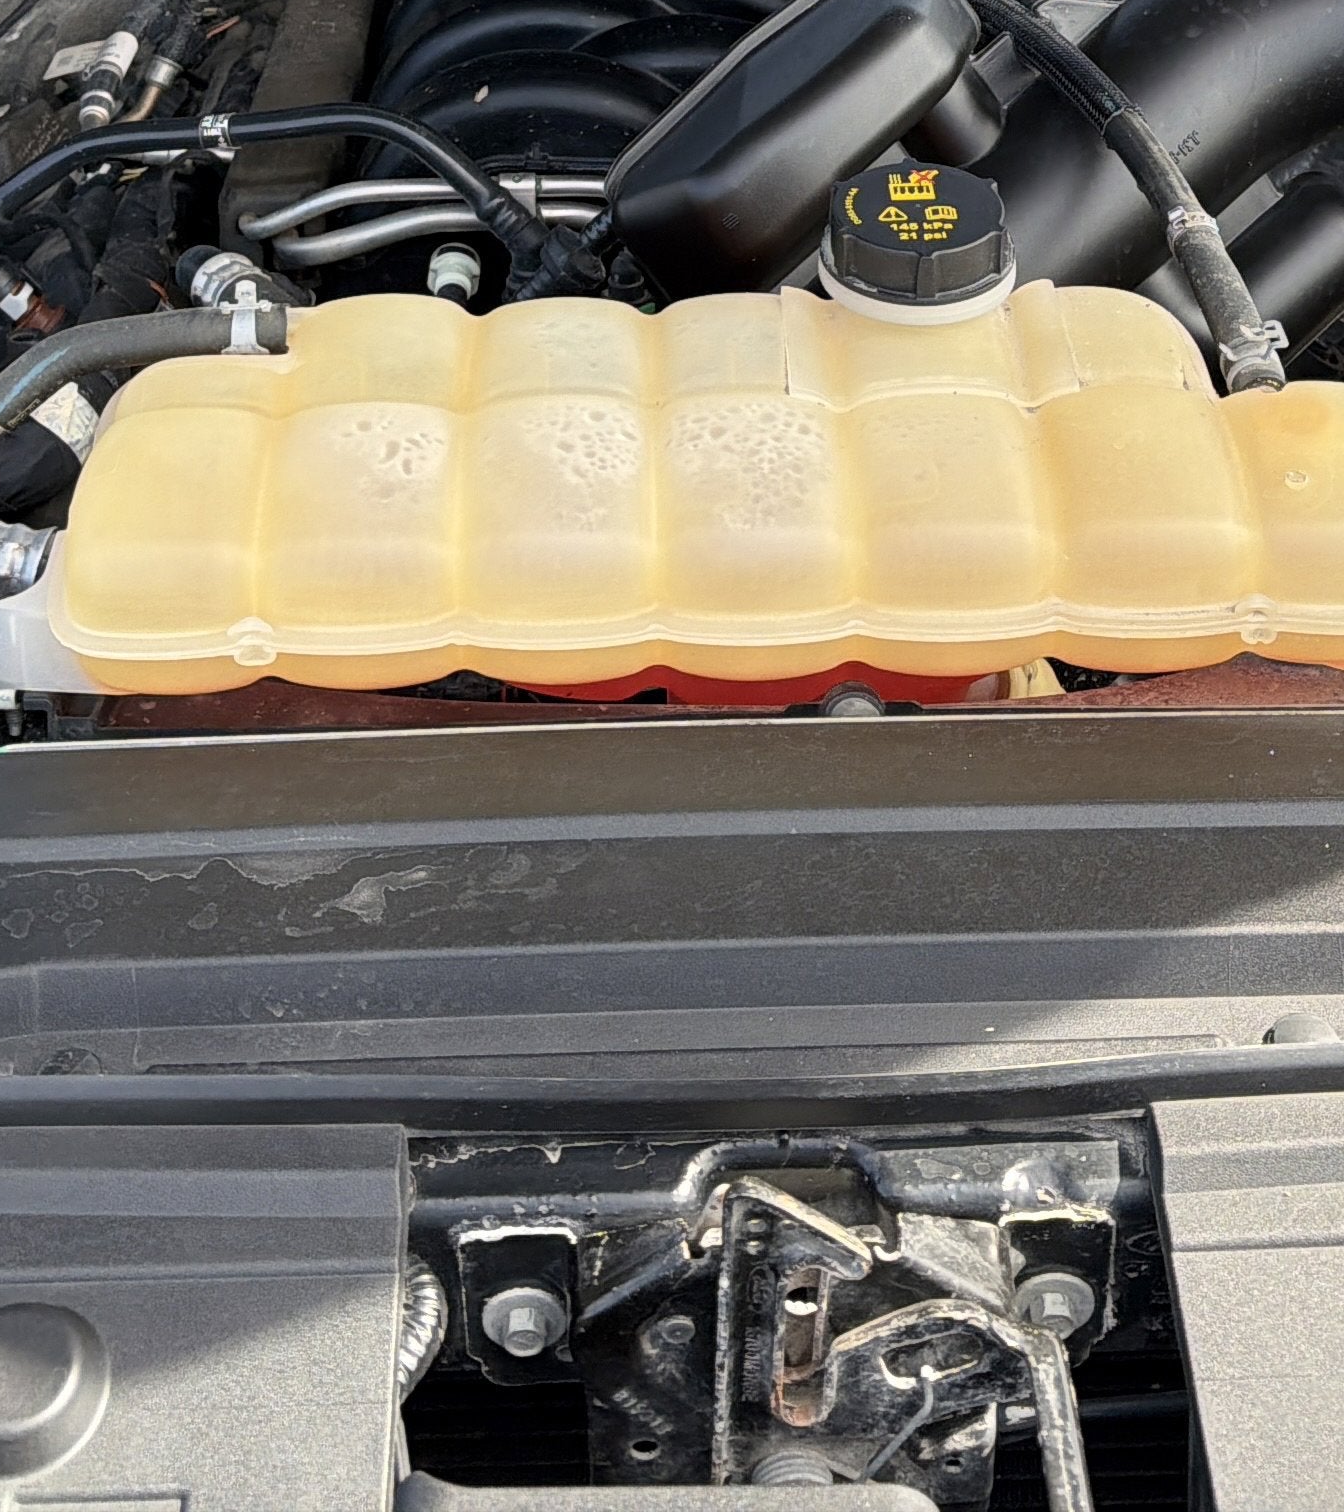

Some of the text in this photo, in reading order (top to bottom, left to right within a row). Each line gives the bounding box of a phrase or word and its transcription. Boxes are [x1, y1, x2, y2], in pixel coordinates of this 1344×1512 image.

[889, 221, 954, 232] 145 kPa
[899, 231, 948, 242] 21 psi
